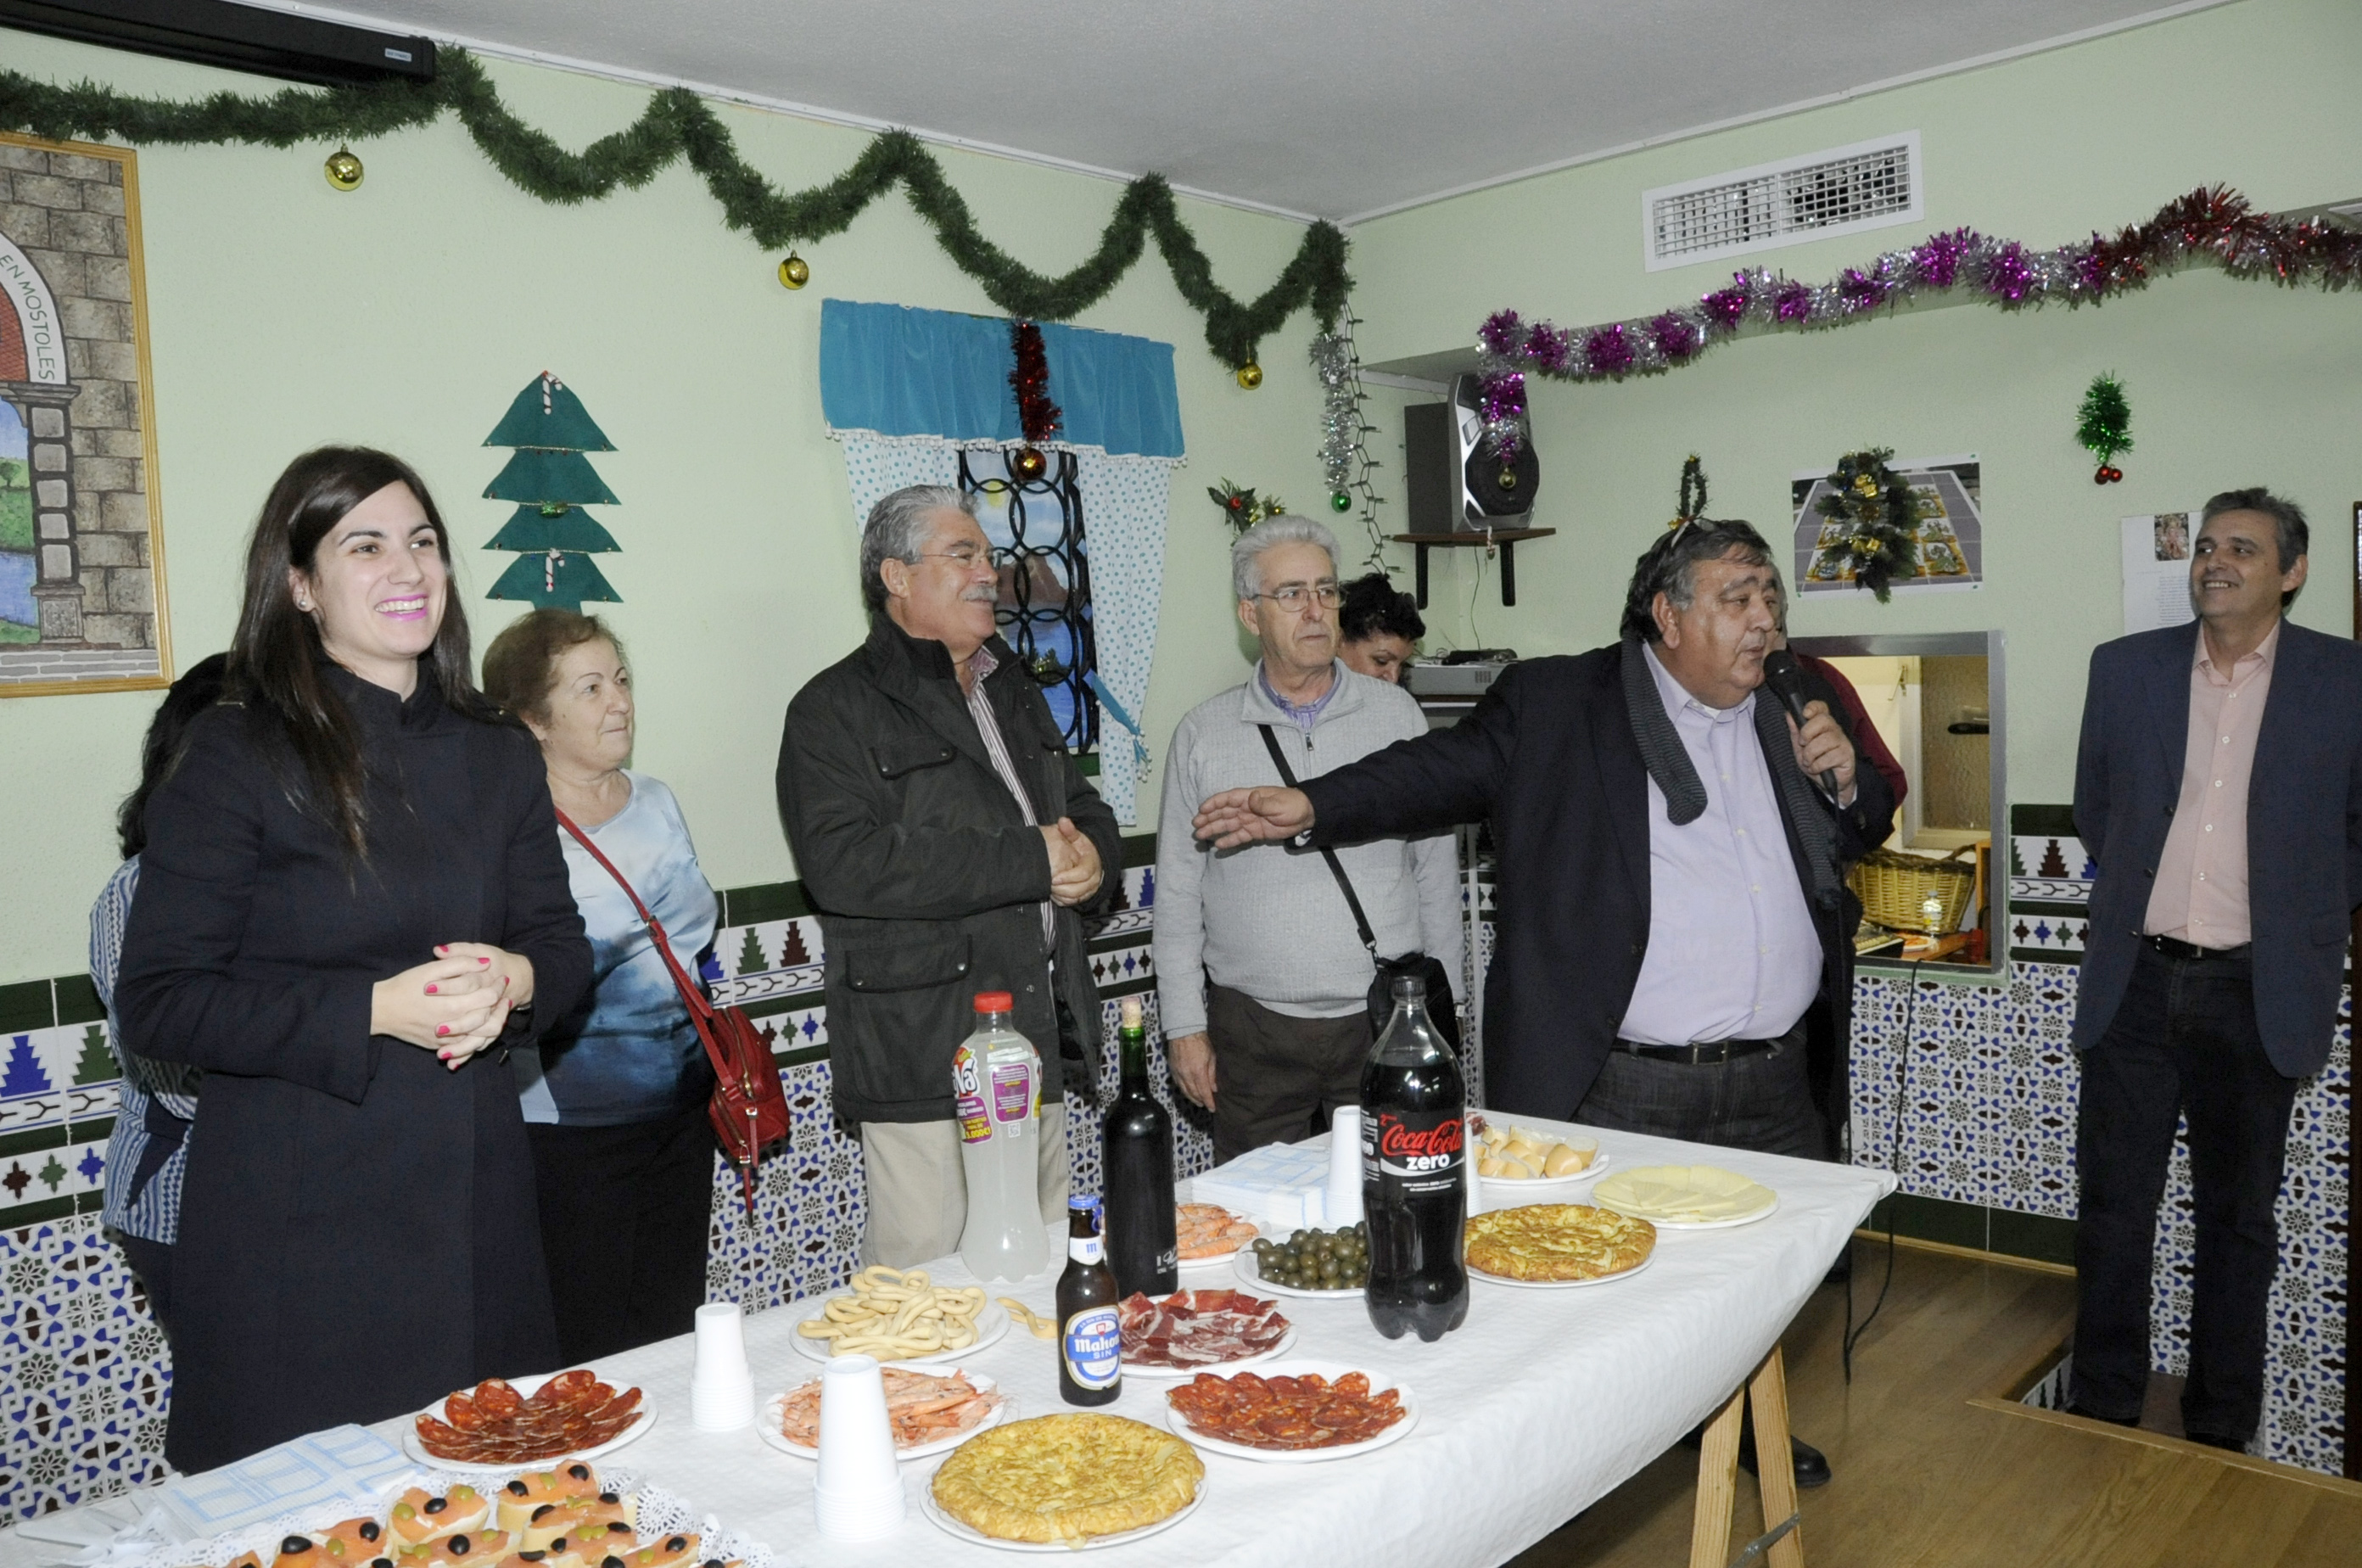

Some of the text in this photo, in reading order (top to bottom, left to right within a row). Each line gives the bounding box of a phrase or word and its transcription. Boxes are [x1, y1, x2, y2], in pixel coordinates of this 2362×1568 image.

[0, 255, 55, 380] EN MOSTOLES
[1406, 1153, 1450, 1170] zero
[1093, 1350, 1112, 1359] SIN
